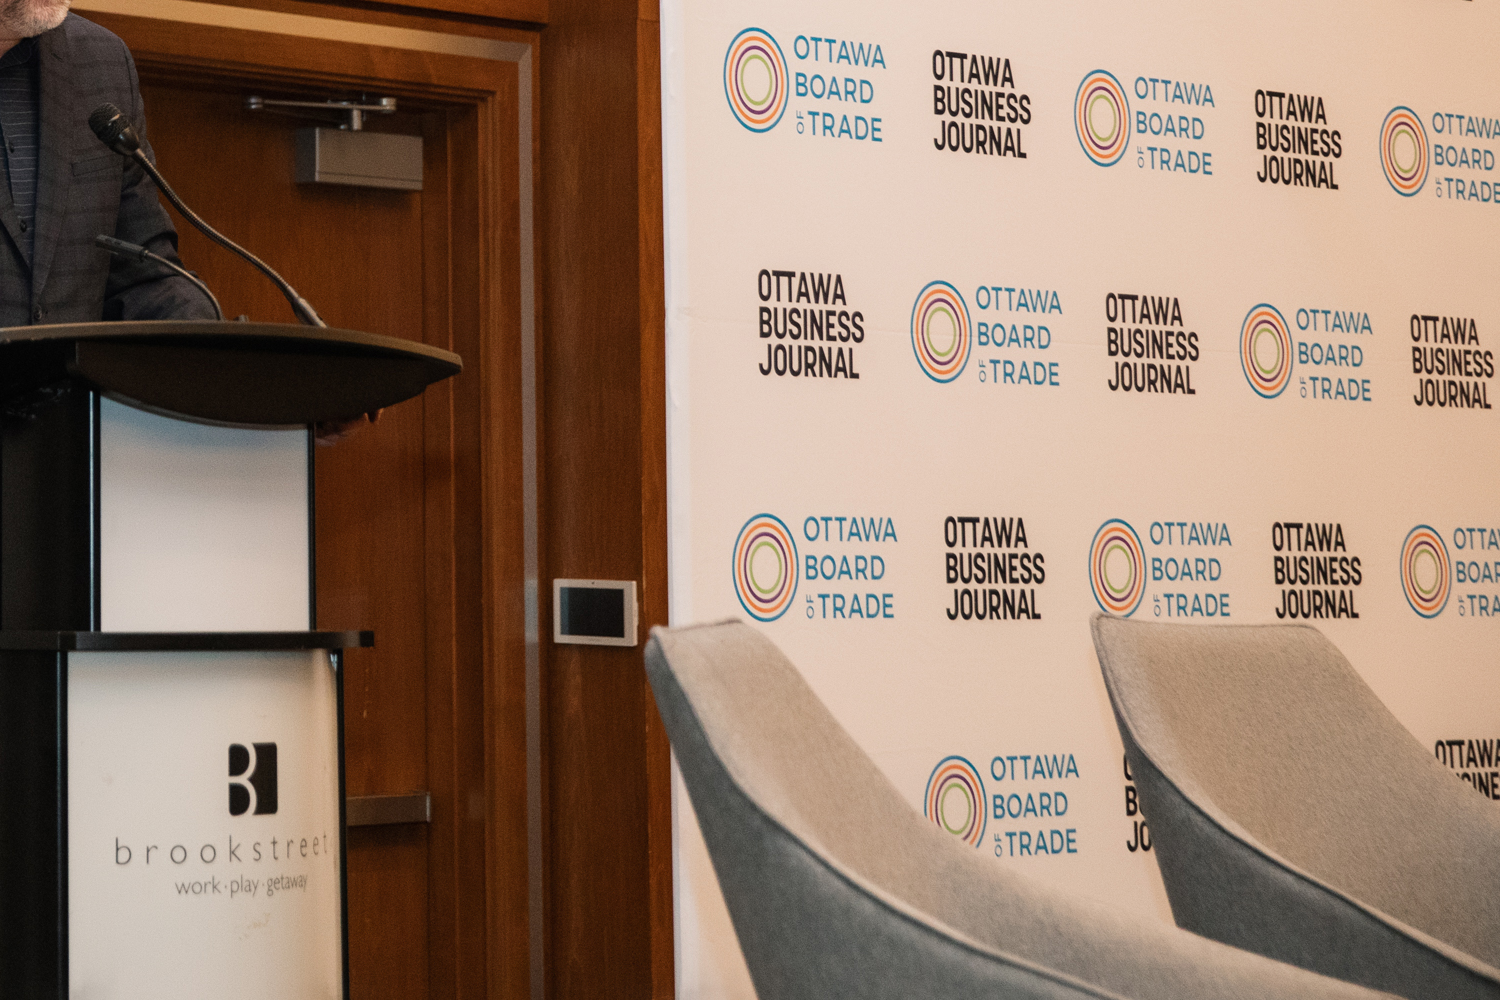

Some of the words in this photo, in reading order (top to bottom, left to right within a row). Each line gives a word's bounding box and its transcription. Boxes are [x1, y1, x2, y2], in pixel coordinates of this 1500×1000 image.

[794, 35, 886, 69] OTTAWA
[933, 50, 1014, 88] OTTAWA
[796, 72, 873, 103] BOARD
[1135, 77, 1215, 107] OTTAWA
[934, 85, 1031, 125] BUSINESS
[1255, 89, 1327, 125] OTTAWA
[808, 111, 882, 142] TRADE
[934, 121, 1027, 158] JOURNAL
[1136, 111, 1204, 140] BOARD
[1256, 122, 1342, 158] BUSINESS
[1147, 147, 1212, 175] TRADE
[1257, 155, 1338, 190] JOURNAL
[1434, 144, 1494, 171] BOARD
[758, 269, 846, 305] OTTAWA
[976, 286, 1062, 314] OTTAWA
[759, 306, 864, 343] BUSINESS
[1106, 293, 1183, 326] OTTAWA
[1296, 308, 1372, 334] OTTAWA
[978, 322, 1051, 349] BOARD
[1107, 327, 1199, 361] BUSINESS
[1410, 314, 1479, 345] OTTAWA
[759, 344, 859, 379] JOURNAL
[1298, 342, 1363, 367] BOARD
[1412, 346, 1494, 378] BUSINESS
[989, 359, 1059, 386] TRADE
[1108, 362, 1196, 394] JOURNAL
[1309, 376, 1371, 401] TRADE
[1414, 379, 1491, 409] JOURNAL
[804, 516, 897, 542] OTTAWA
[945, 516, 1028, 548] OTTAWA
[1150, 522, 1231, 545] OTTAWA
[1272, 522, 1346, 552] OTTAWA
[1454, 528, 1500, 550] OTTA
[805, 555, 885, 580] BOARD
[946, 552, 1045, 584] BUSINESS
[1152, 558, 1221, 581] BOARD
[1274, 556, 1362, 586] BUSINESS
[818, 594, 894, 618] TRADE
[946, 589, 1041, 620] JOURNAL
[1163, 593, 1230, 617] TRADE
[1276, 589, 1359, 619] JOURNAL
[991, 754, 1079, 781] OTTAWA
[993, 792, 1068, 819] BOARD
[115, 832, 328, 865] brookstreet
[1005, 829, 1077, 856] TRADE
